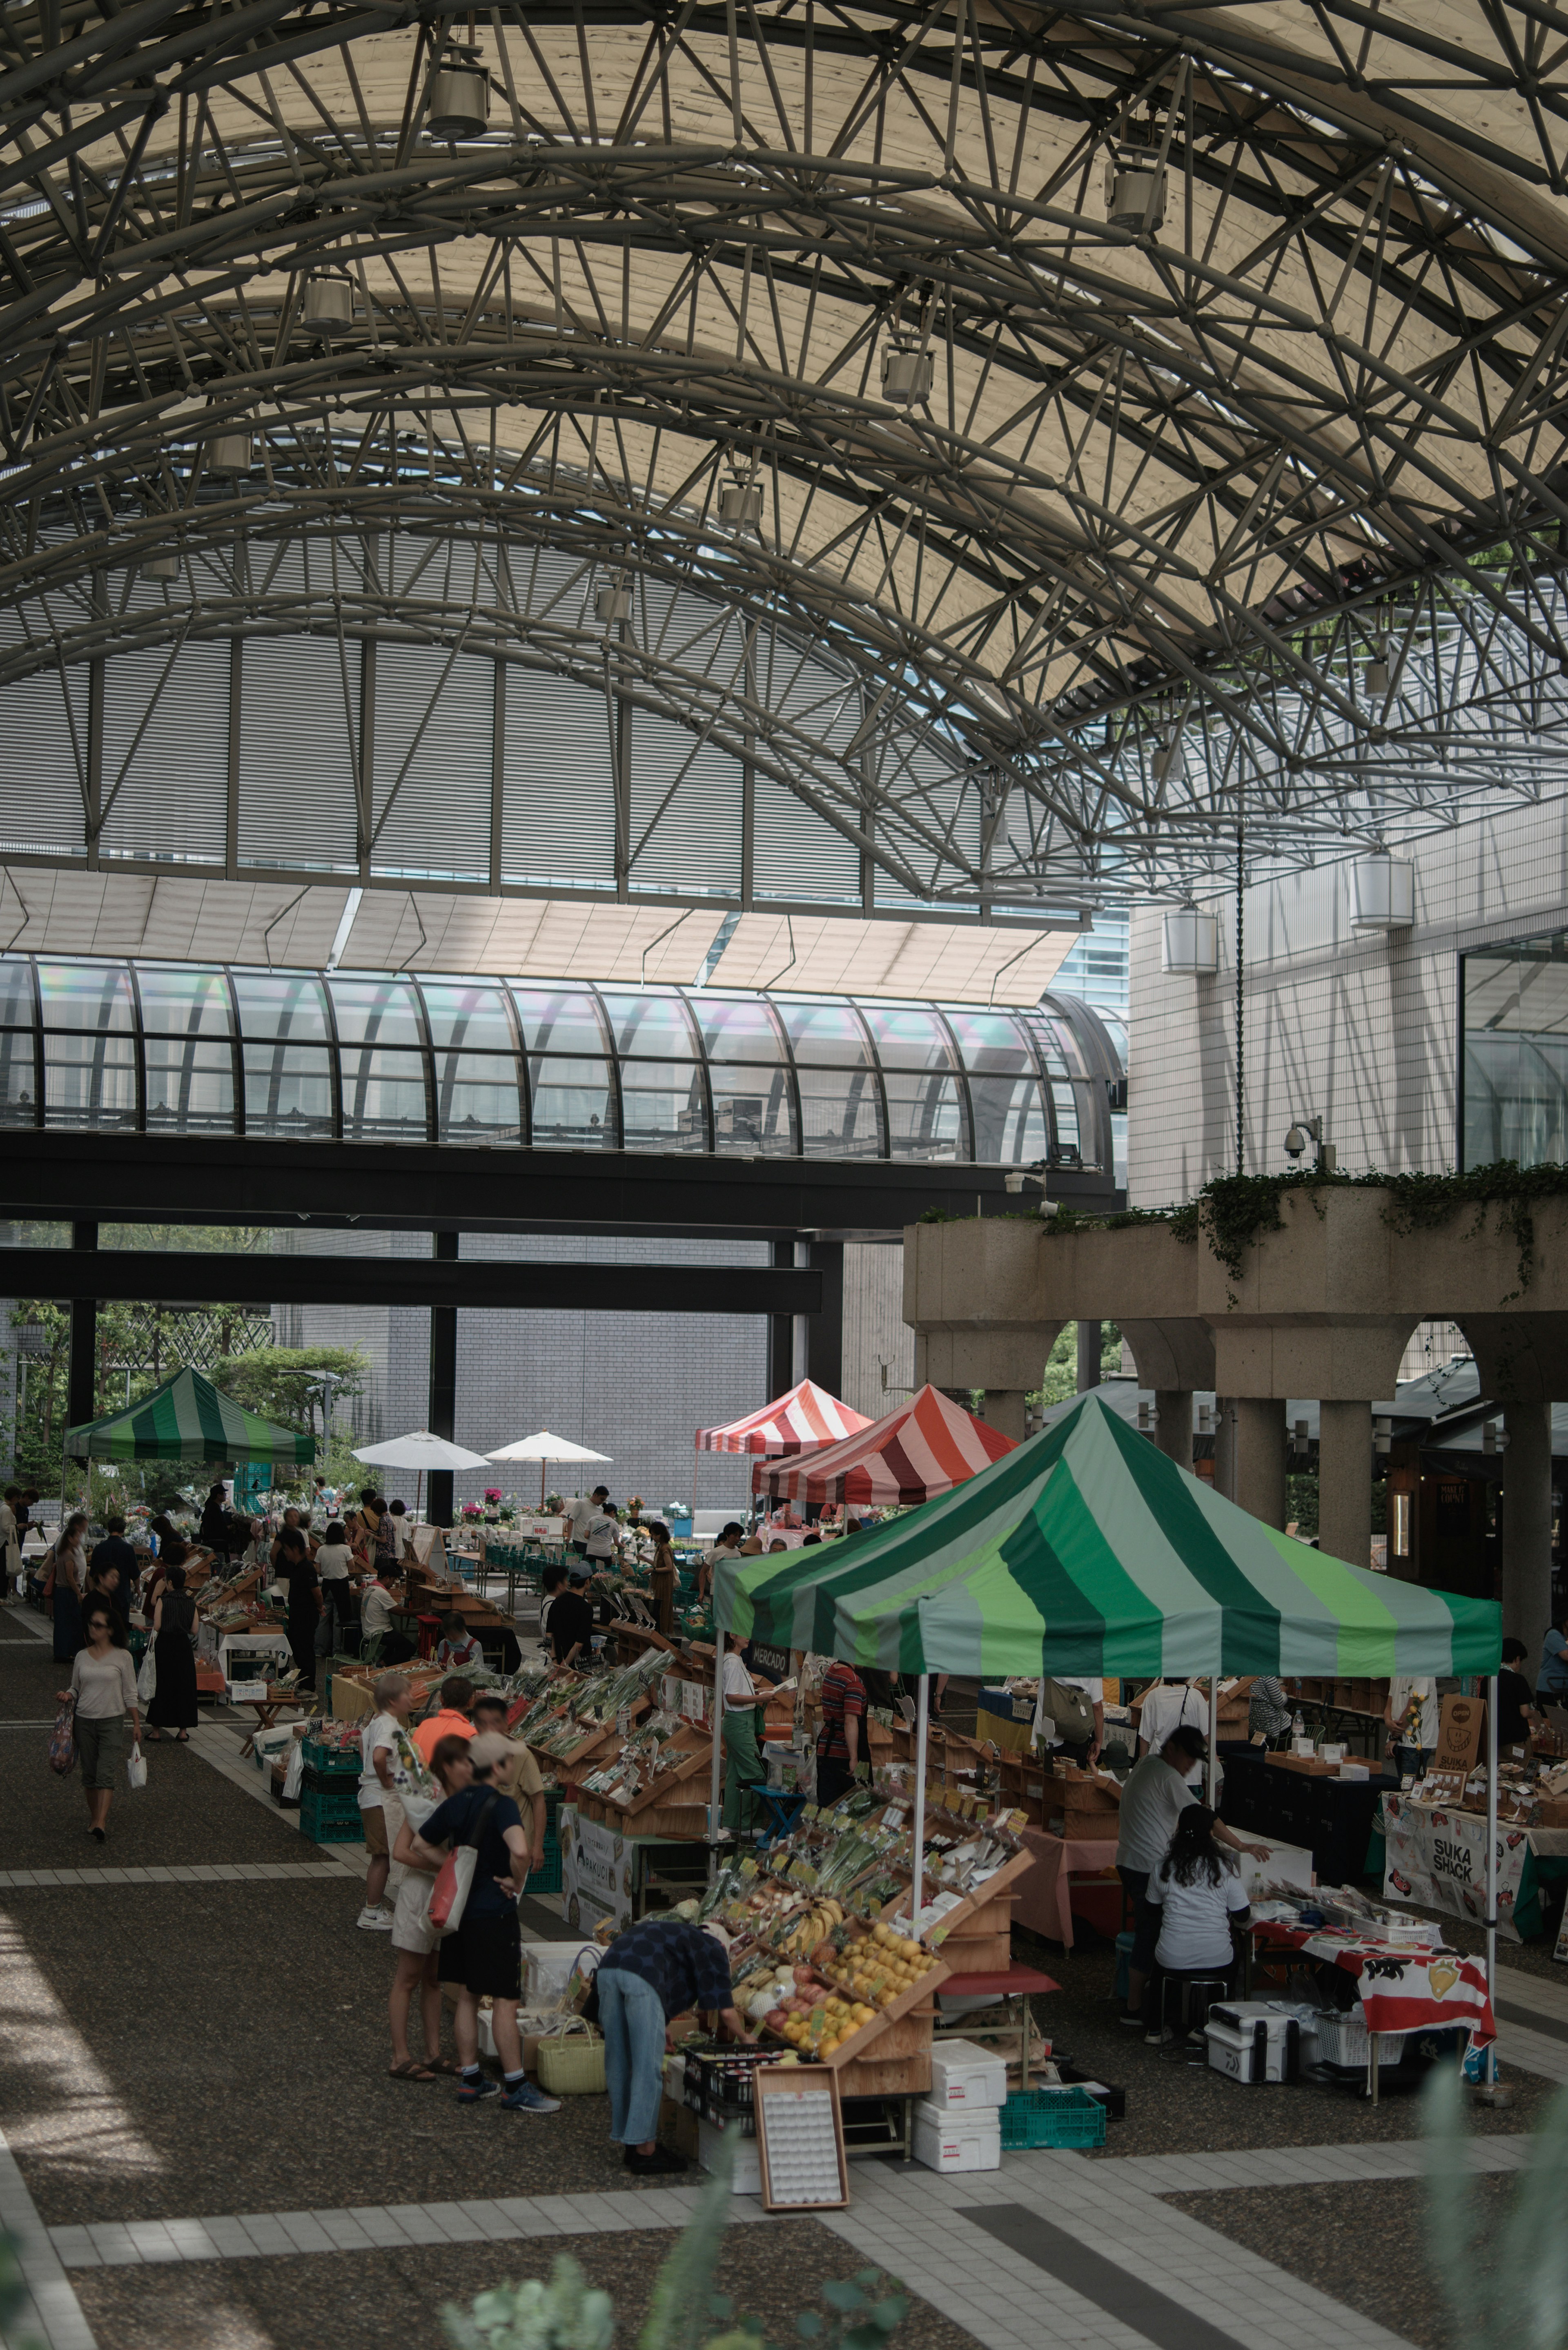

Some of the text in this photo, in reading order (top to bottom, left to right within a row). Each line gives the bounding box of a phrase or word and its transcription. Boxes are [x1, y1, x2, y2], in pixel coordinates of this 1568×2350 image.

[1441, 1485, 1464, 1494] MAKE IT
[1441, 1494, 1465, 1504] COUNT
[754, 1646, 786, 1671] MERCADO
[1441, 1756, 1468, 1768] SUIKA
[586, 1857, 608, 1880] PAKUCI
